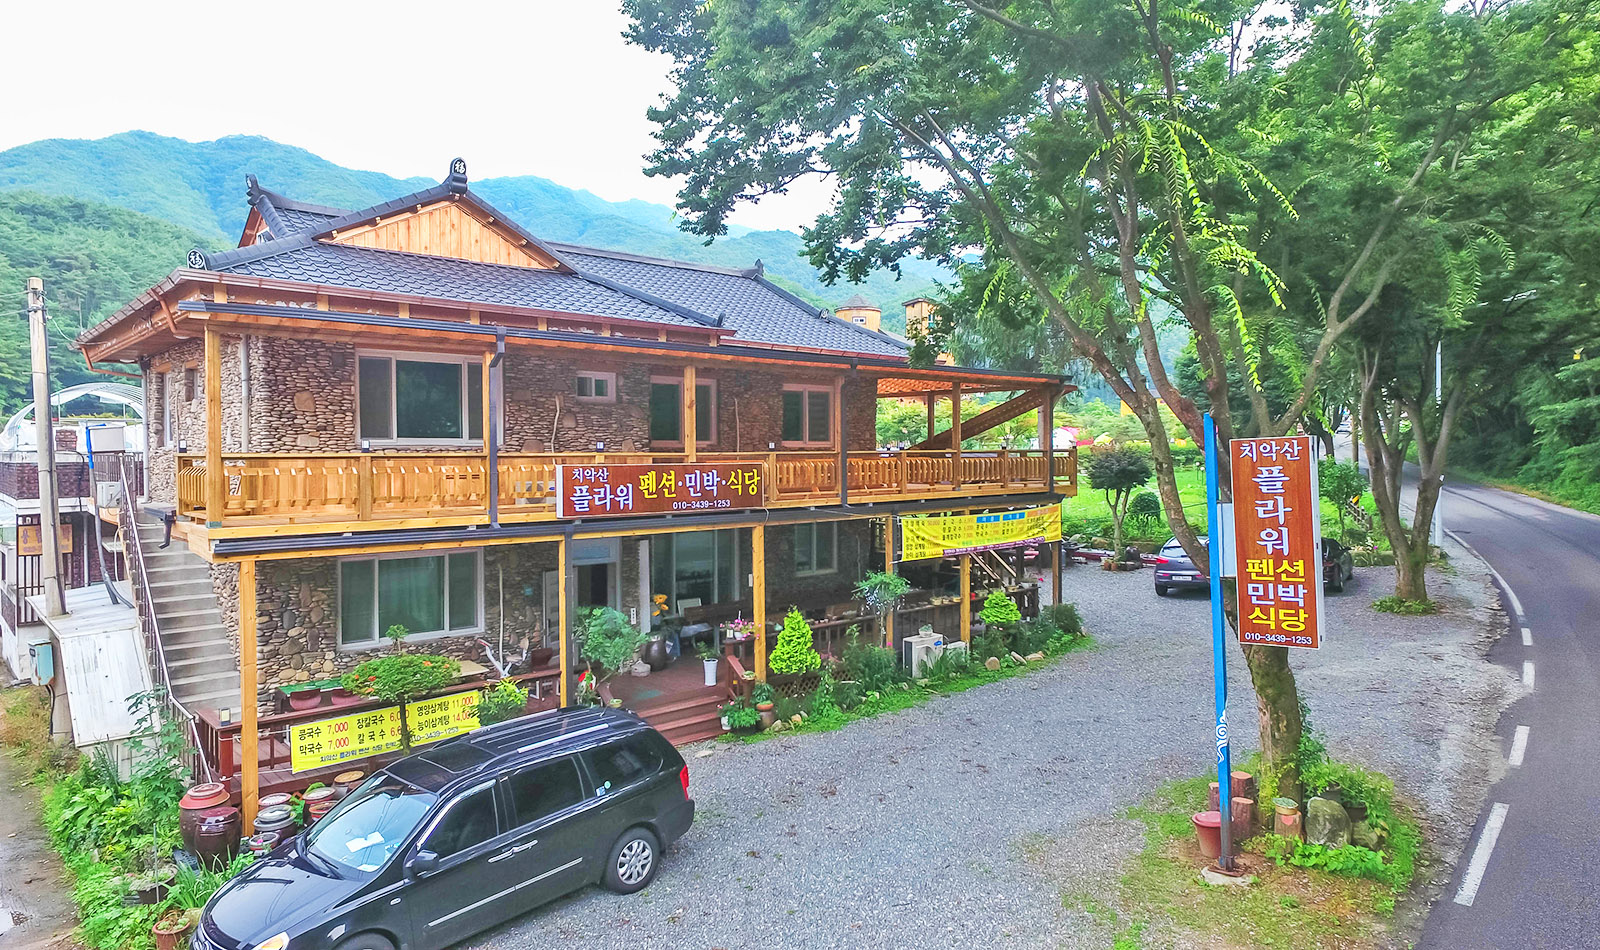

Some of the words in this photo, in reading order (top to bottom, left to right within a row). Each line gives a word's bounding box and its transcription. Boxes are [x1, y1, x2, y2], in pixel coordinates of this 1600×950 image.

[1239, 439, 1302, 462] 치악산
[572, 467, 609, 483] 치악산
[570, 483, 634, 512] 플라워
[673, 499, 731, 510] 010-3439-1253
[1251, 465, 1292, 556] 플라워
[1245, 558, 1305, 582] 펜션
[1247, 583, 1308, 607] 민박
[1247, 607, 1308, 632] 식당
[1245, 632, 1312, 645] 010-3439-1253
[298, 726, 322, 741] 콩국수
[327, 721, 349, 735] 7,000
[356, 714, 385, 730] 장칼국수
[390, 709, 410, 722] 6,00
[417, 700, 450, 717] 영양삼계탕
[452, 695, 474, 708] 11,000
[299, 742, 323, 756] 막국수
[328, 737, 350, 750] 7,000
[417, 715, 450, 732] 능이삼계탕
[453, 710, 472, 722] 14,00
